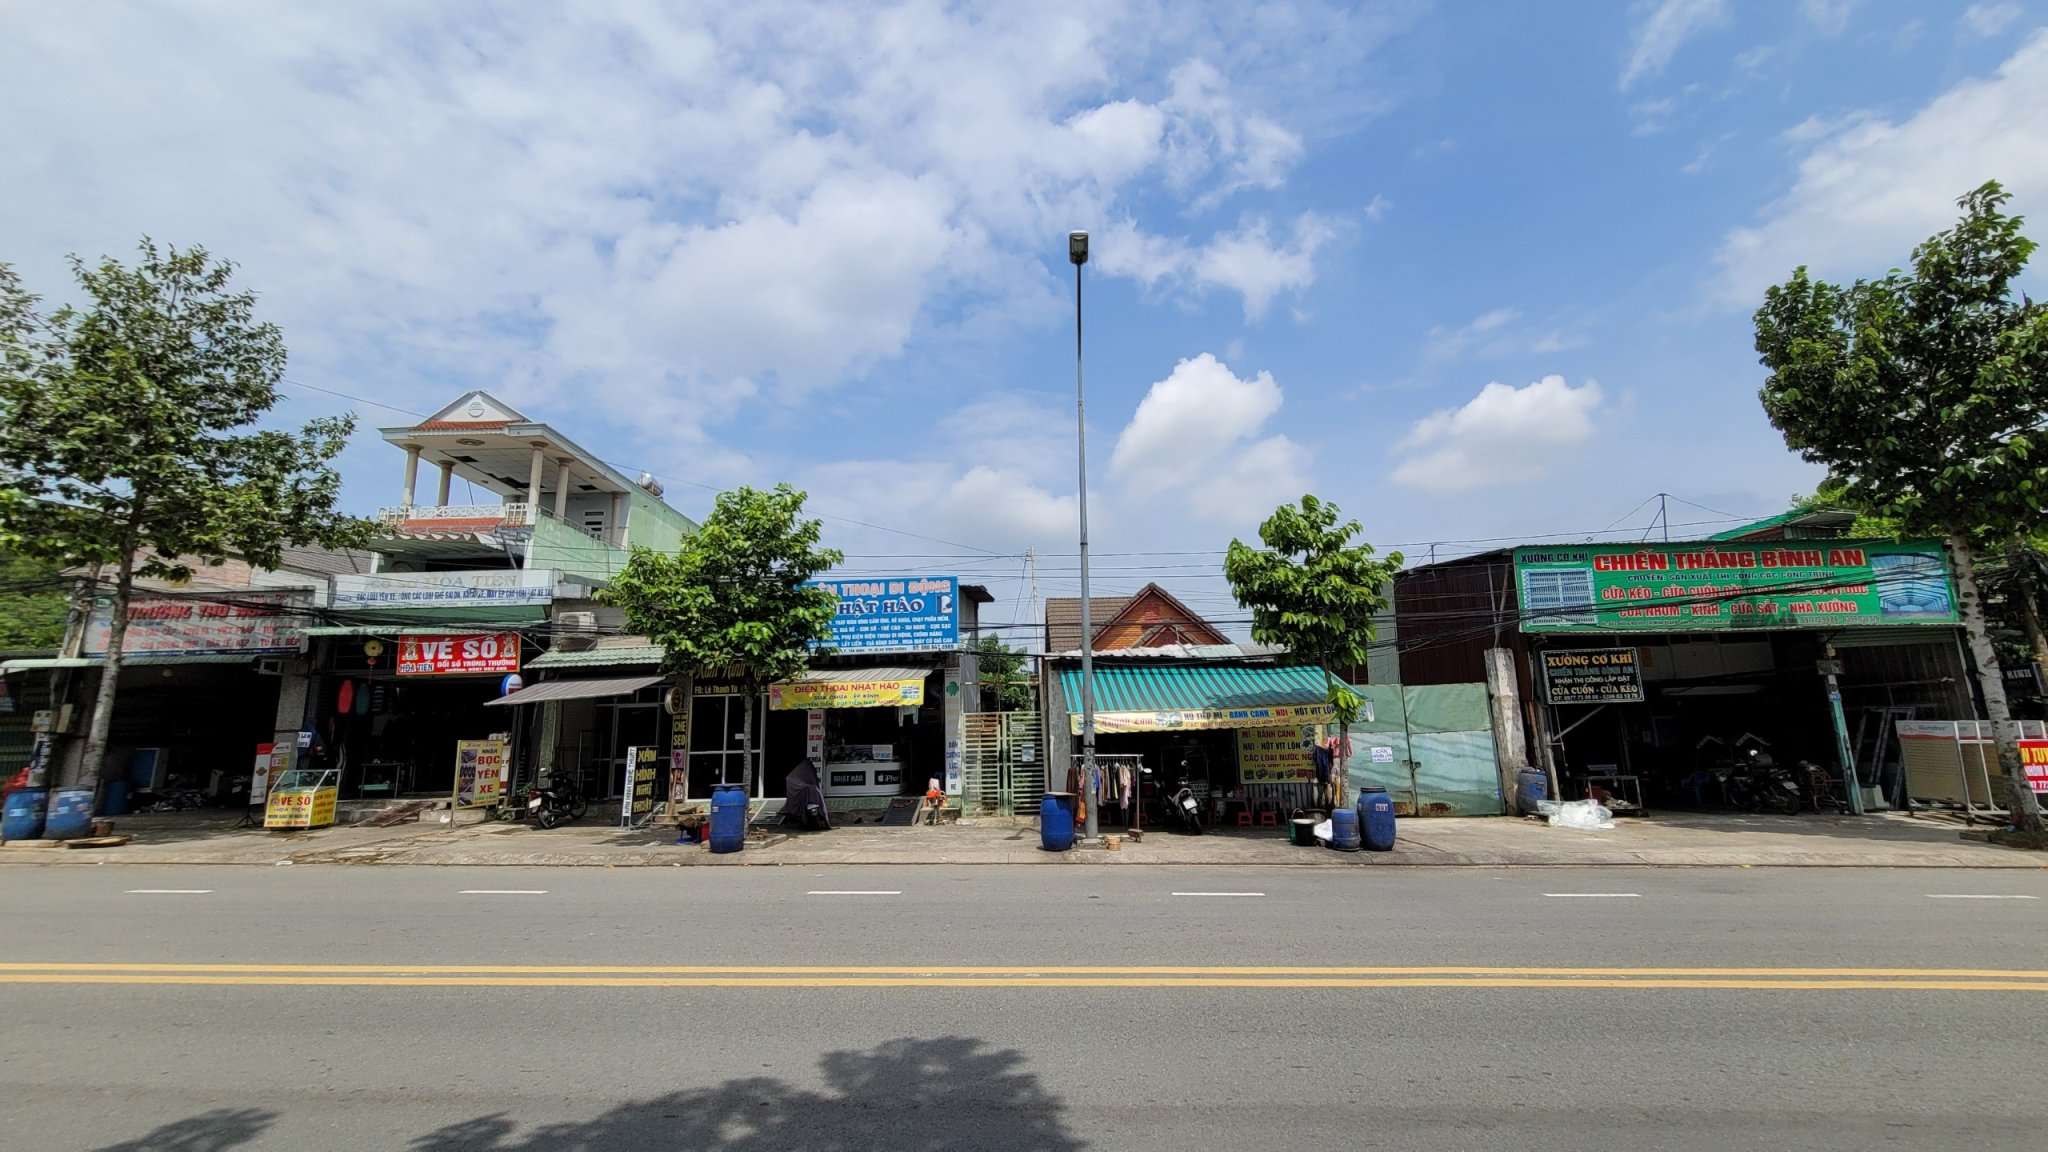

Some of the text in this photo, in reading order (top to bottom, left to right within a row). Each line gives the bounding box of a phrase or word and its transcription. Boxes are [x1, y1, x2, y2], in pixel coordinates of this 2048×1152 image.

[1760, 547, 1824, 568] BÌNH
[1828, 549, 1866, 567] AN
[841, 582, 885, 598] THOẠI
[889, 581, 904, 594] DI
[908, 578, 951, 596] ĐỘNG
[835, 597, 879, 618] HẬT
[1788, 600, 1814, 614] NHÀ
[422, 637, 454, 660] VÉ
[477, 755, 501, 768] BỌC
[477, 767, 499, 780] YÊN
[479, 784, 494, 794] XE
